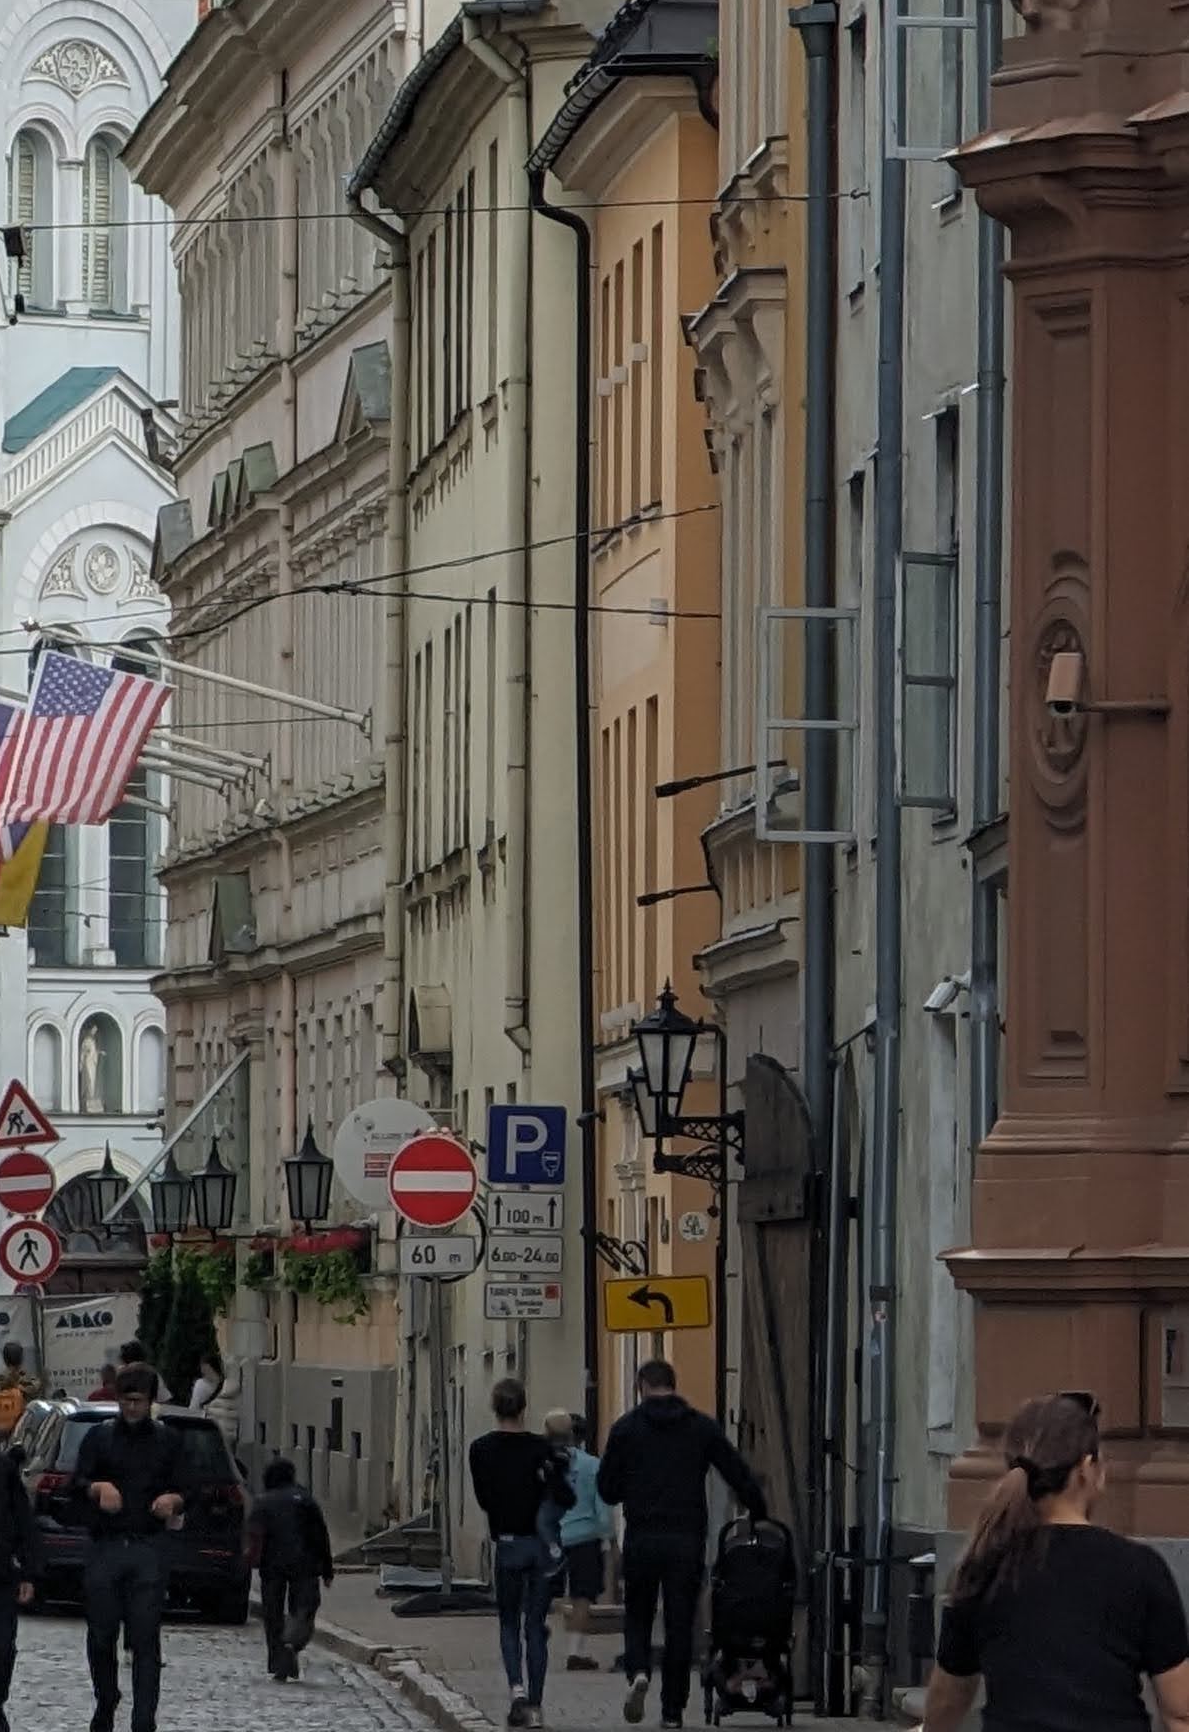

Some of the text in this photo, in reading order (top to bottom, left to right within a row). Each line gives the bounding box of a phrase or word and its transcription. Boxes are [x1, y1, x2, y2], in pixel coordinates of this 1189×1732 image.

[505, 1115, 548, 1174] P
[507, 1209, 544, 1224] 100 m
[411, 1244, 461, 1264] 60 m
